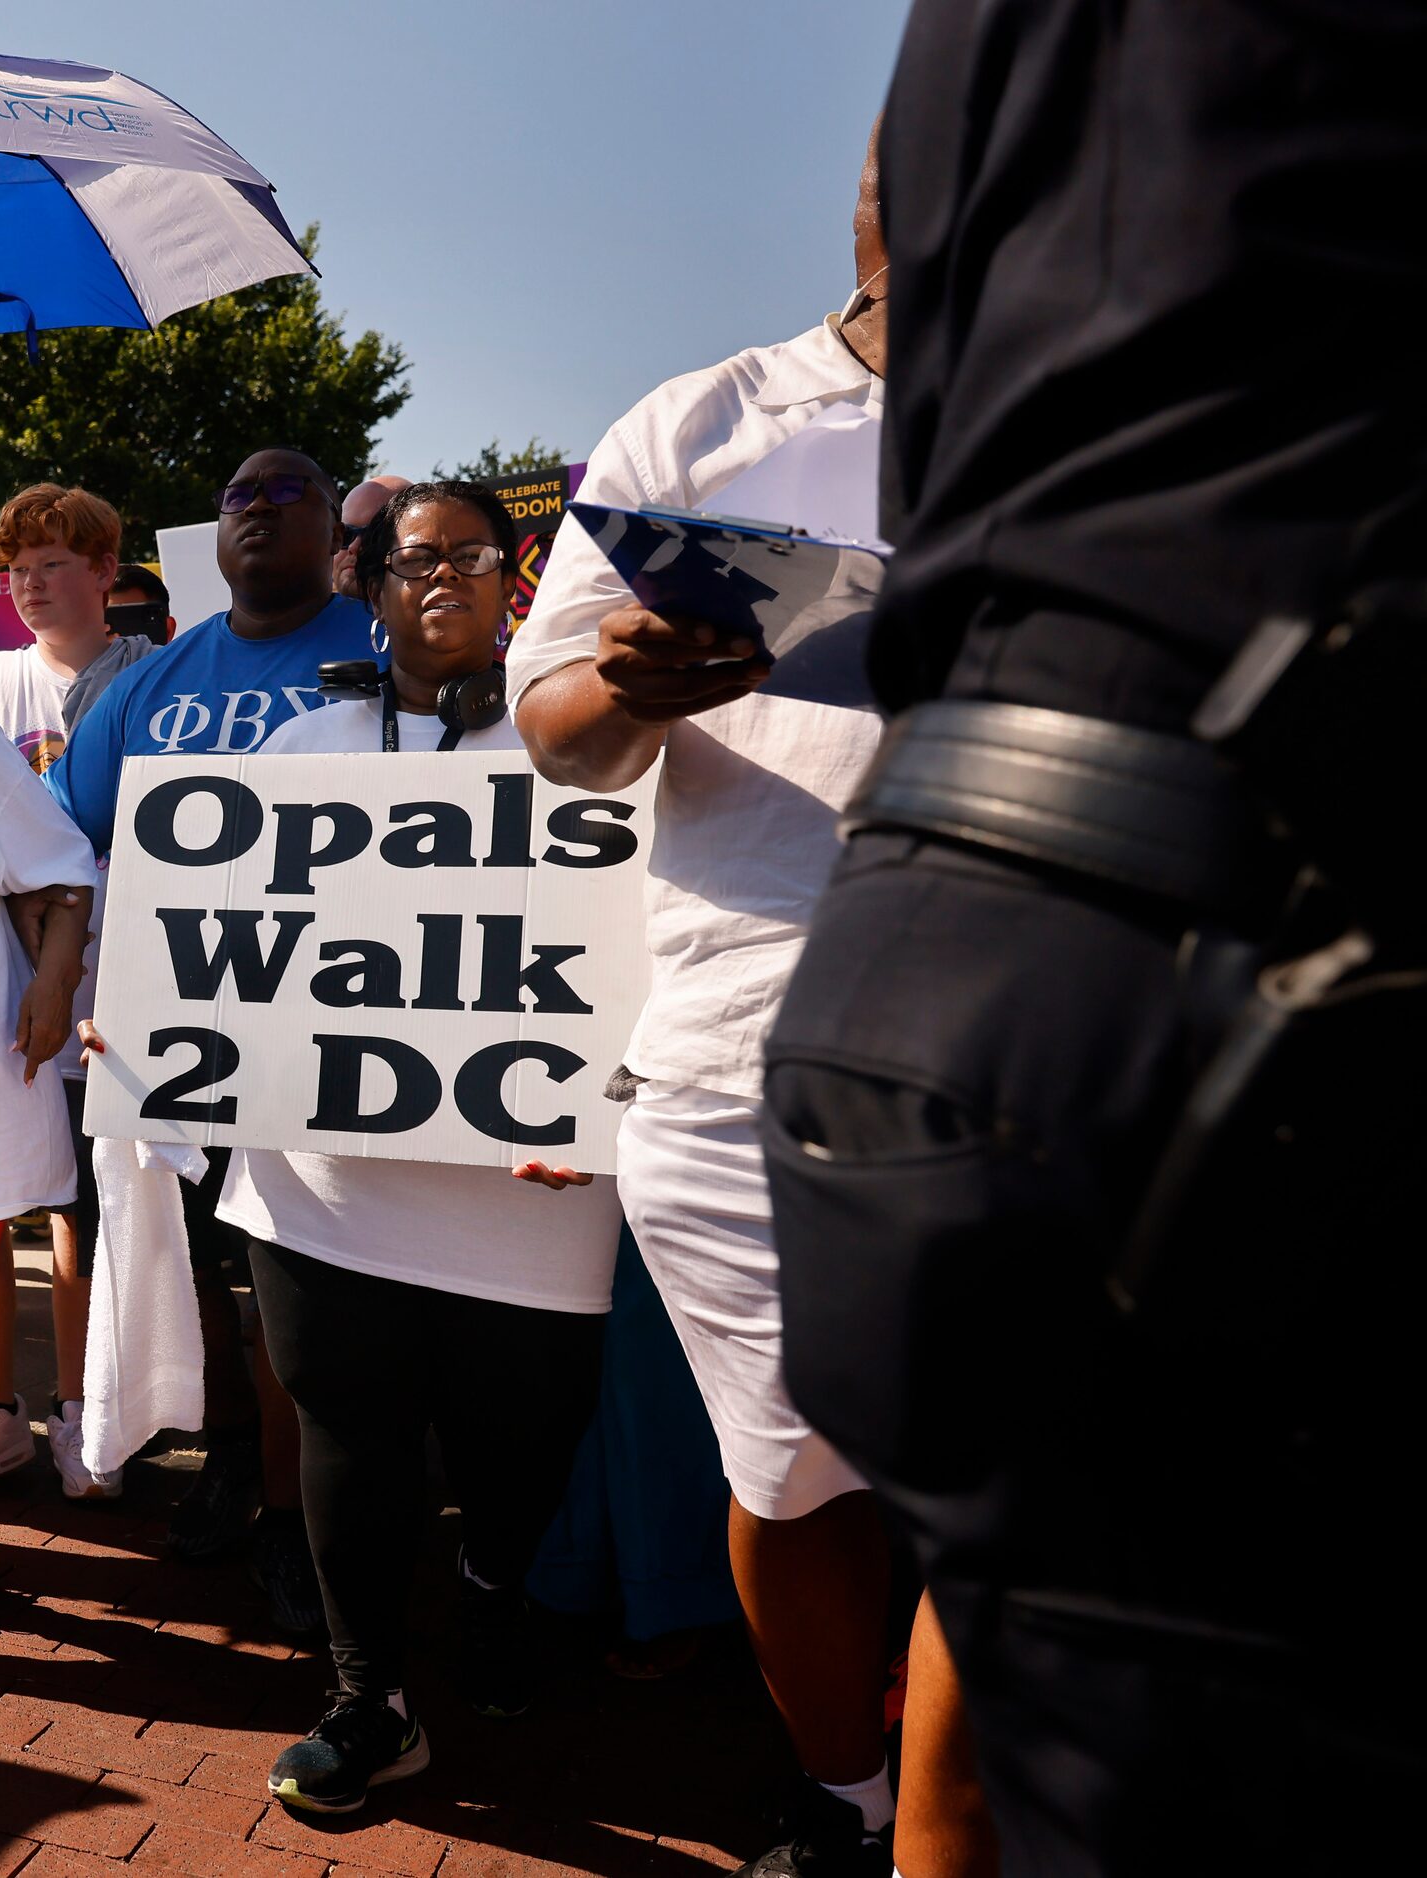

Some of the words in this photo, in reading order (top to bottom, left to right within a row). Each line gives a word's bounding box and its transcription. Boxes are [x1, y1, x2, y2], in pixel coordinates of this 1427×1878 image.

[495, 480, 561, 499] CELEBRATE
[385, 720, 394, 741] Royal
[133, 773, 639, 895] Opals
[155, 907, 593, 1014] Walk
[139, 1026, 240, 1125] 2
[306, 1033, 588, 1146] DC
